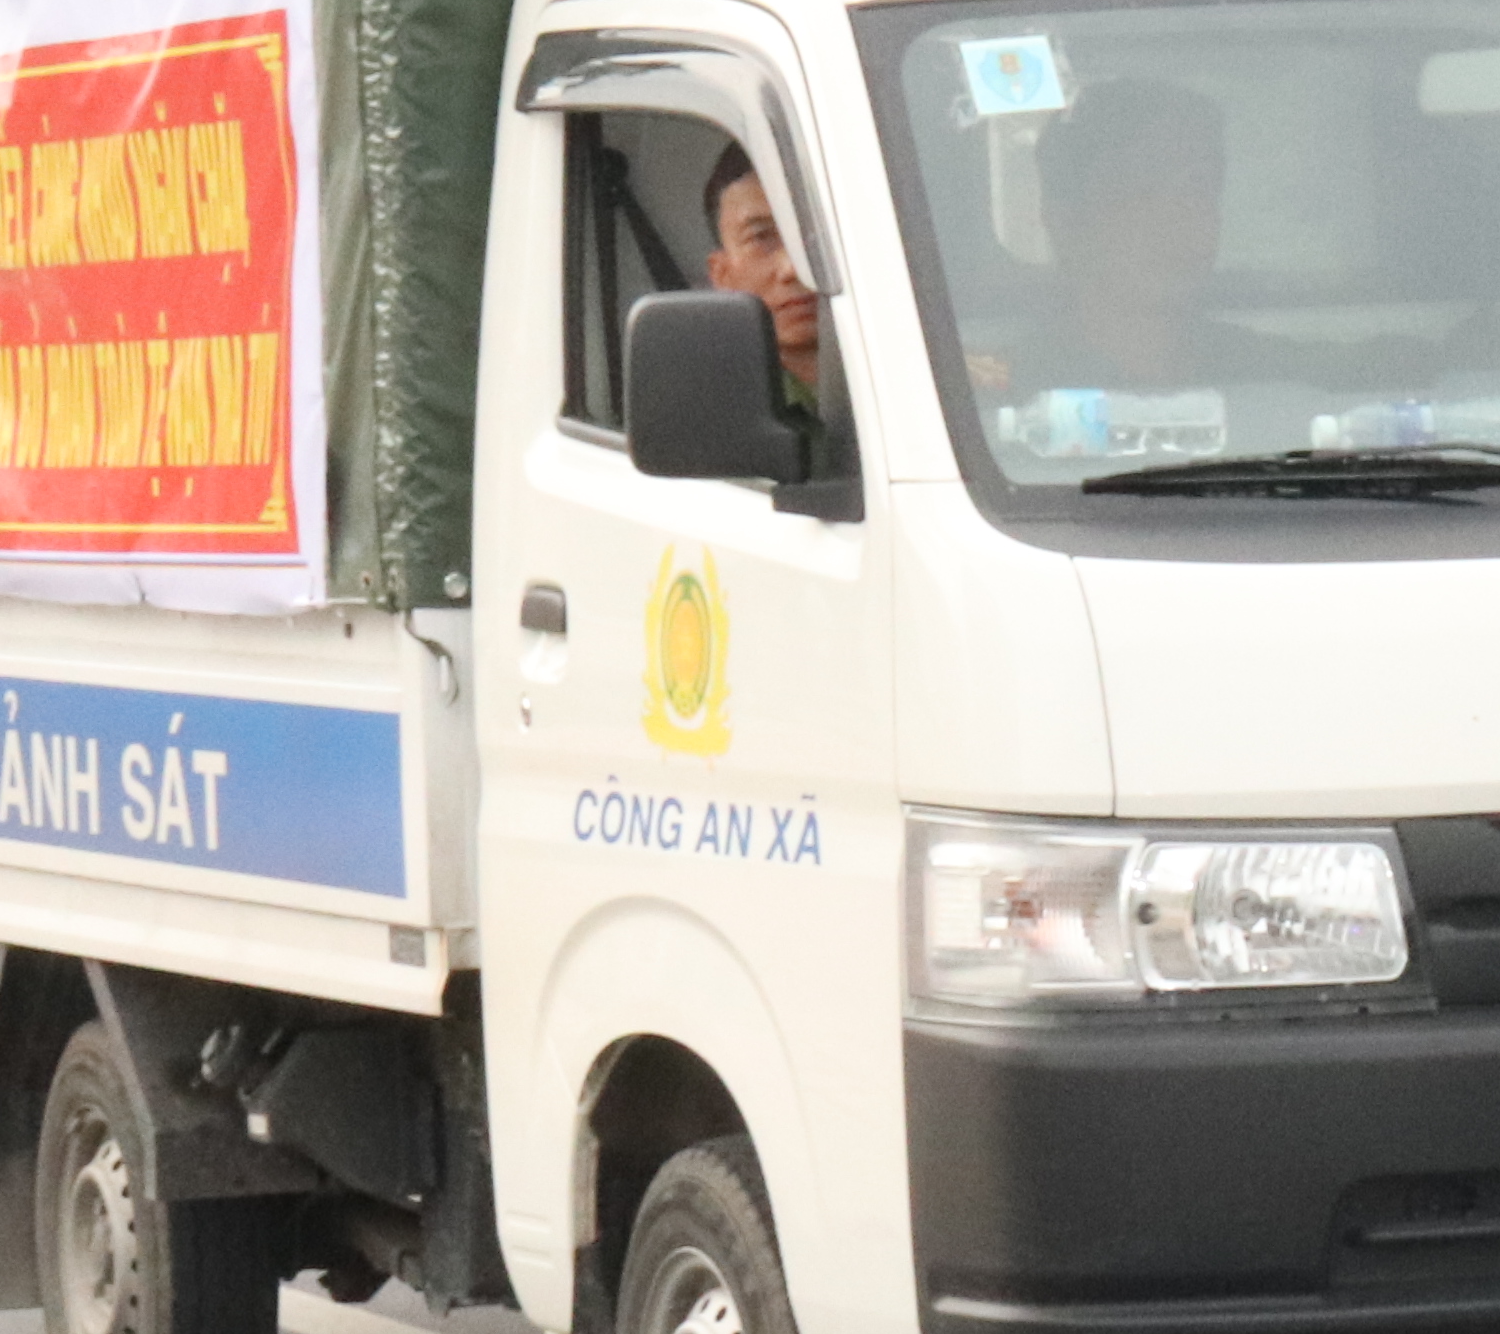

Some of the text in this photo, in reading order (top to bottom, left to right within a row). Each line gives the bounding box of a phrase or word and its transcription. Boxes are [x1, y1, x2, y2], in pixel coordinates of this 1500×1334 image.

[121, 712, 229, 851] SÁT
[573, 774, 822, 866] CÔNG AN XÃ
